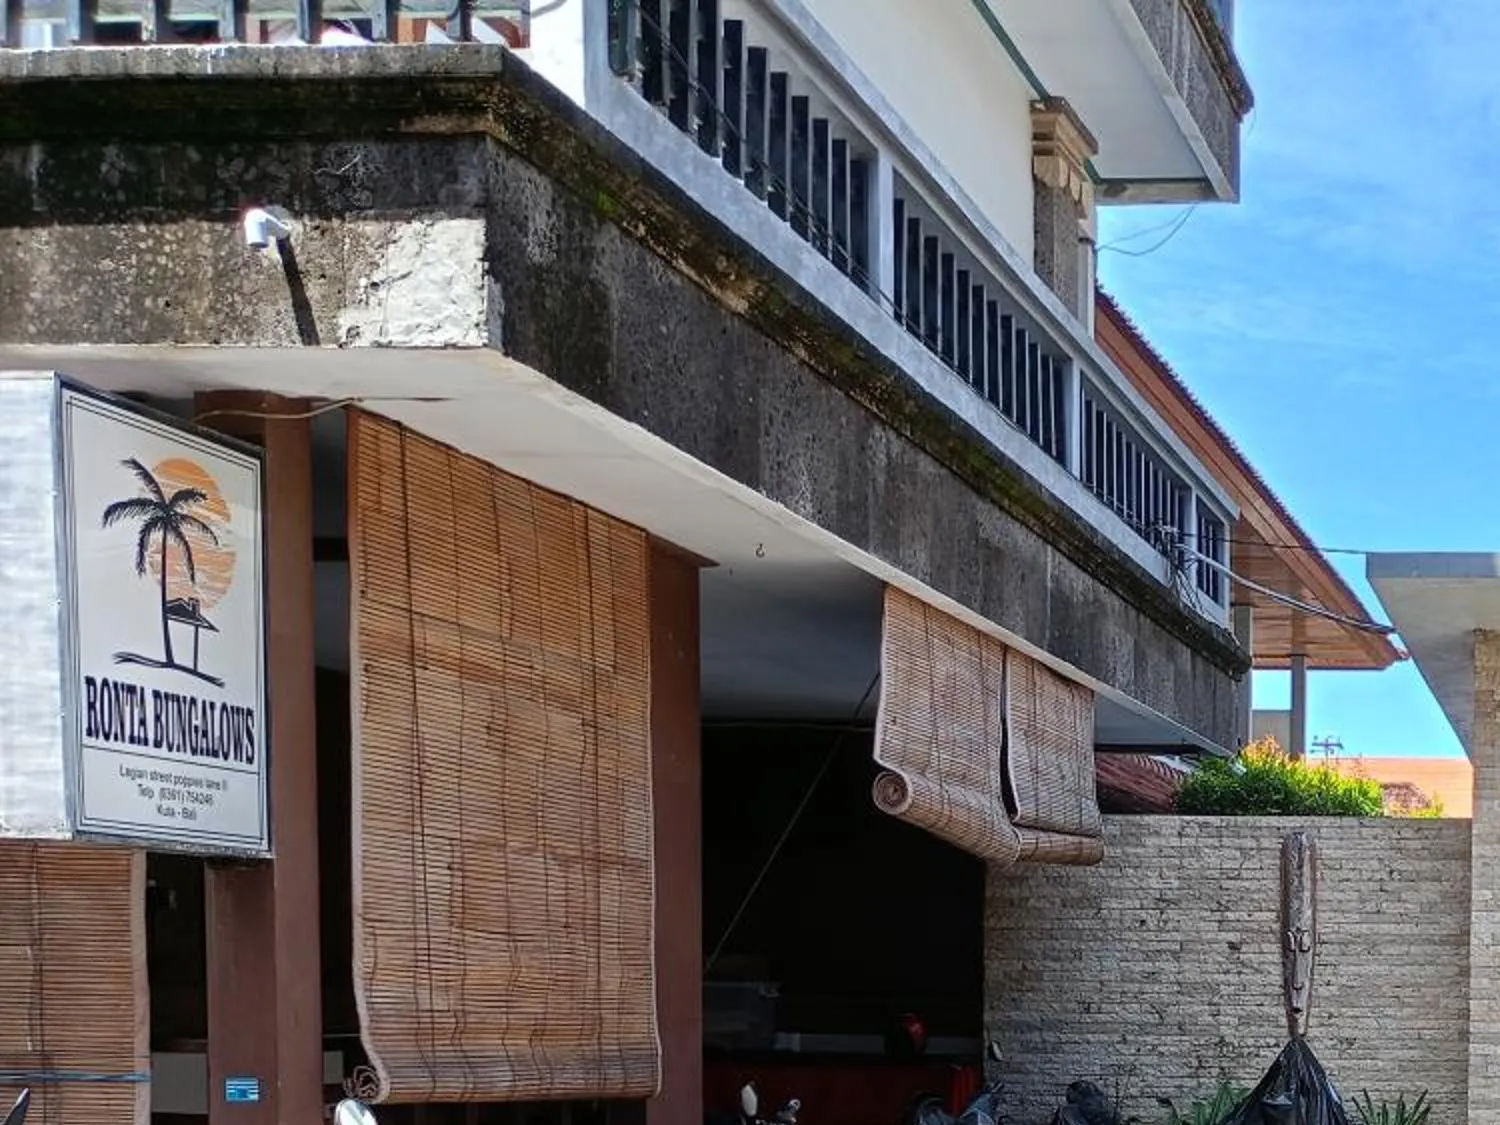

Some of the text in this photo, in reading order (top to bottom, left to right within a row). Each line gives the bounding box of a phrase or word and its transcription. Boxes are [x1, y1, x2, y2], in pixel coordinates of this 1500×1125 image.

[84, 675, 256, 765] RONTA BUNGALOWS
[150, 768, 173, 783] street
[157, 803, 175, 817] Kuta
[182, 806, 197, 820] Bali
